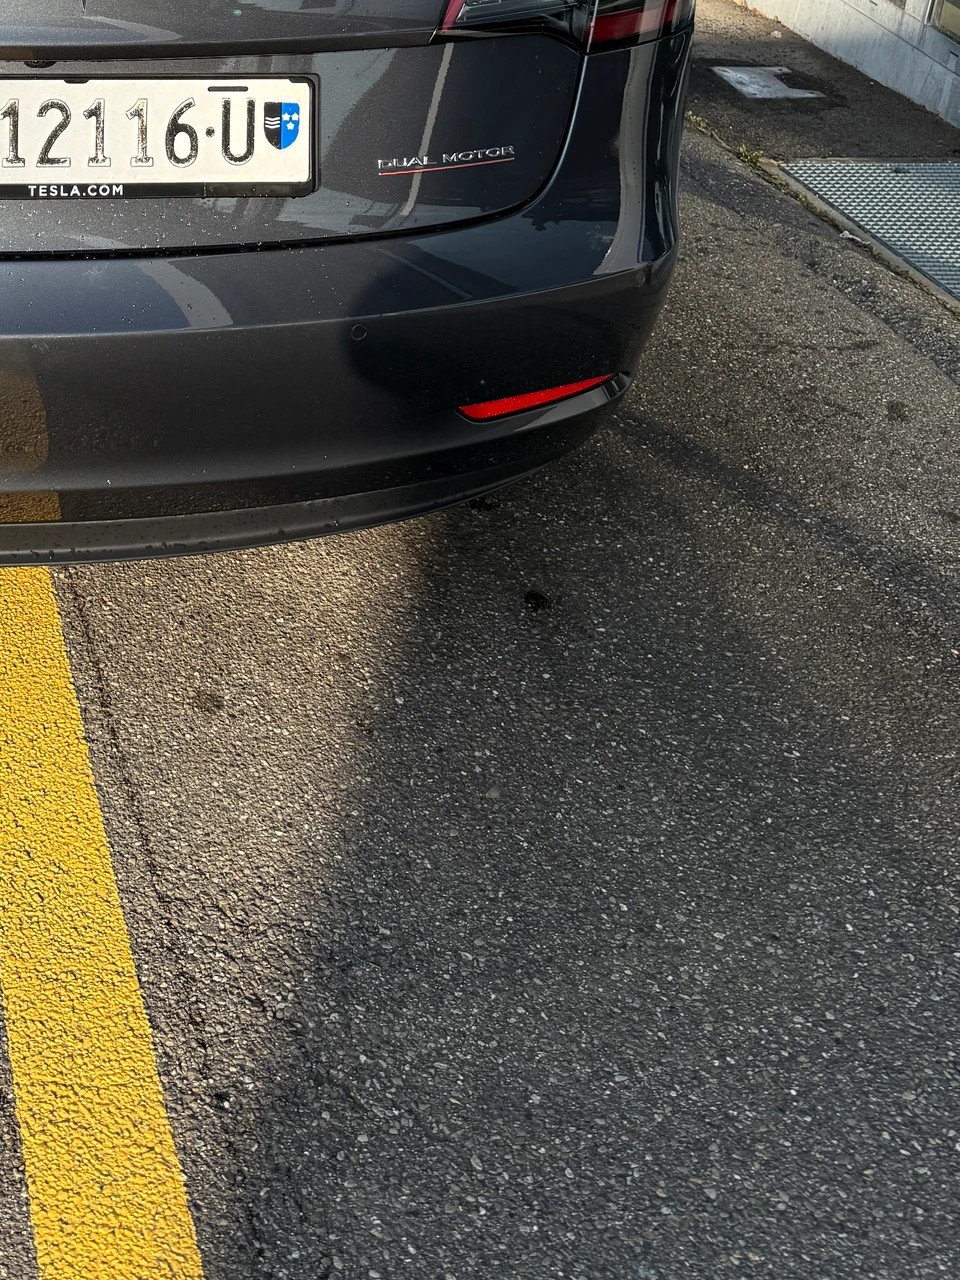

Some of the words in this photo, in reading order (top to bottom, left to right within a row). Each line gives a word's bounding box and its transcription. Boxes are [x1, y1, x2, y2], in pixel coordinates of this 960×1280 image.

[377, 156, 437, 169] DUAL
[442, 145, 515, 163] MOTOR
[27, 184, 125, 198] TESLA.COM
